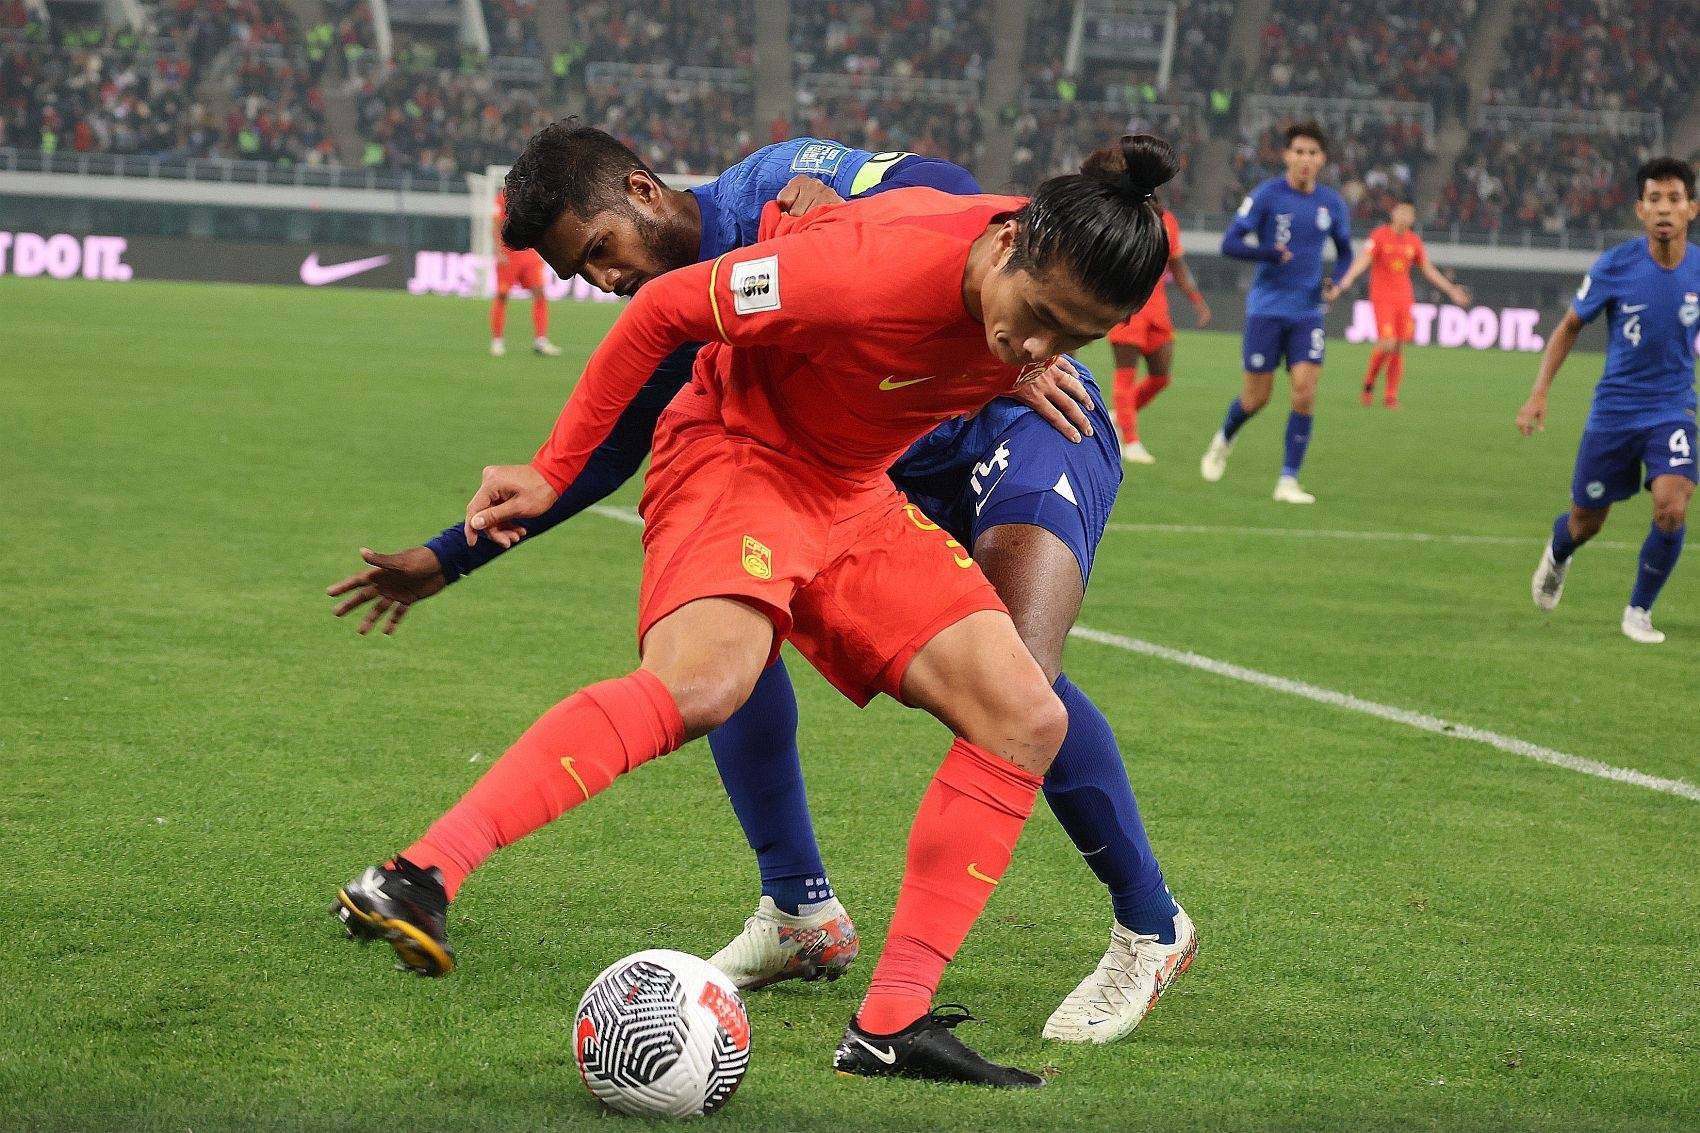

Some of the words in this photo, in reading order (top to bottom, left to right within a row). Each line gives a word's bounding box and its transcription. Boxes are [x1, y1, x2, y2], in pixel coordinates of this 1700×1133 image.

[13, 232, 81, 278] DO
[1438, 304, 1499, 349] DO
[1623, 314, 1642, 347] 4
[1668, 428, 1691, 457] 4
